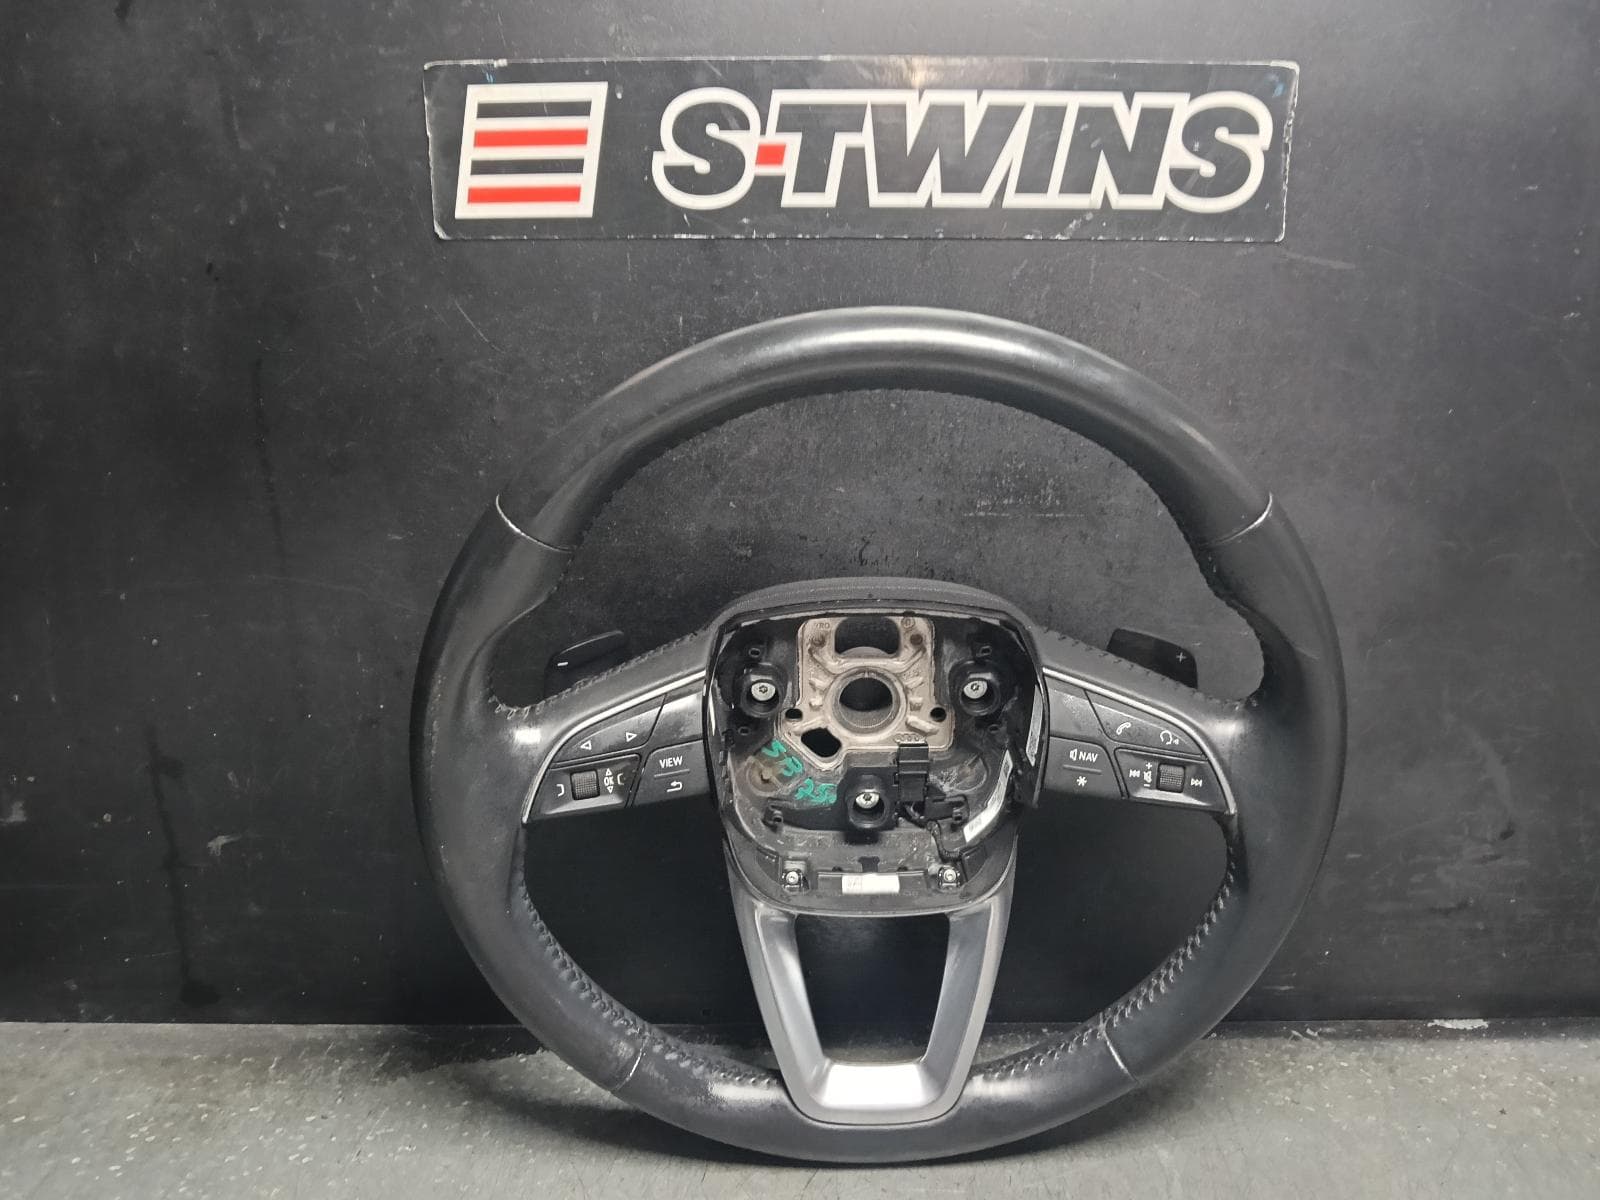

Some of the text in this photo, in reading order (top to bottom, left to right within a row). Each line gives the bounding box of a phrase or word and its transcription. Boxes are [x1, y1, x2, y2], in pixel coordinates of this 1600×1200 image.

[659, 755, 683, 769] VIEW
[1079, 751, 1098, 763] NAV
[603, 776, 614, 787] OK
